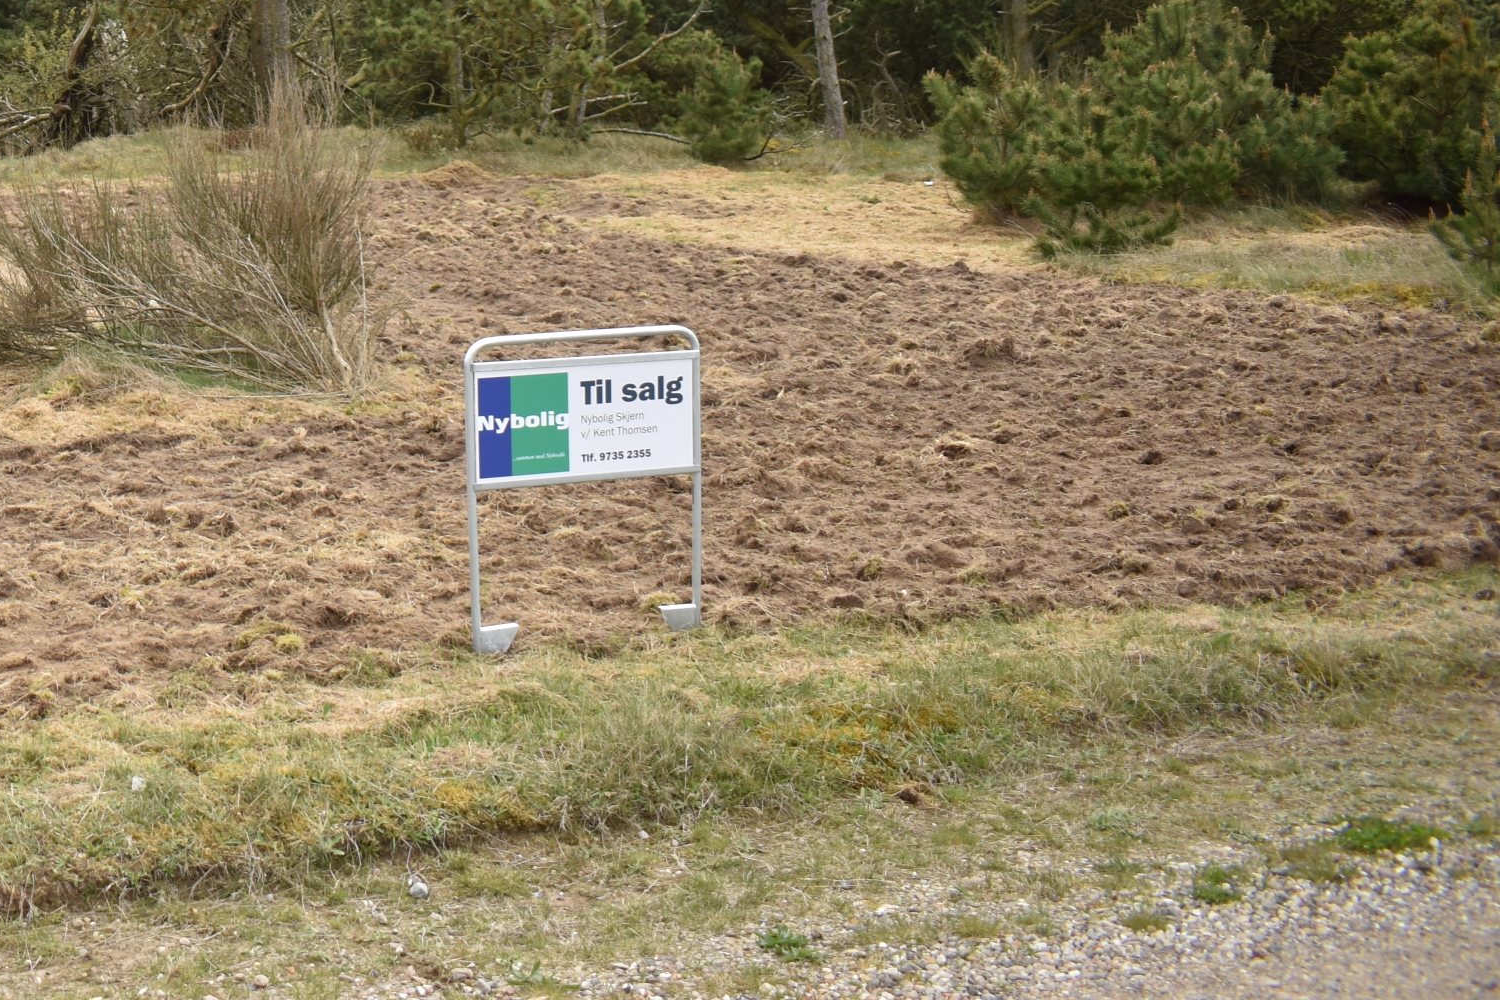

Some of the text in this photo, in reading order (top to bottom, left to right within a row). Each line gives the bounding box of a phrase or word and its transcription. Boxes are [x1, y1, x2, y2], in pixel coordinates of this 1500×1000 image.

[580, 375, 683, 405] Til salg
[477, 411, 569, 434] Nybolig
[581, 412, 644, 425] Nybolig Skjern
[581, 425, 658, 439] v/ Kent Thomsen
[581, 449, 651, 462] Tlf. 9735 2355
